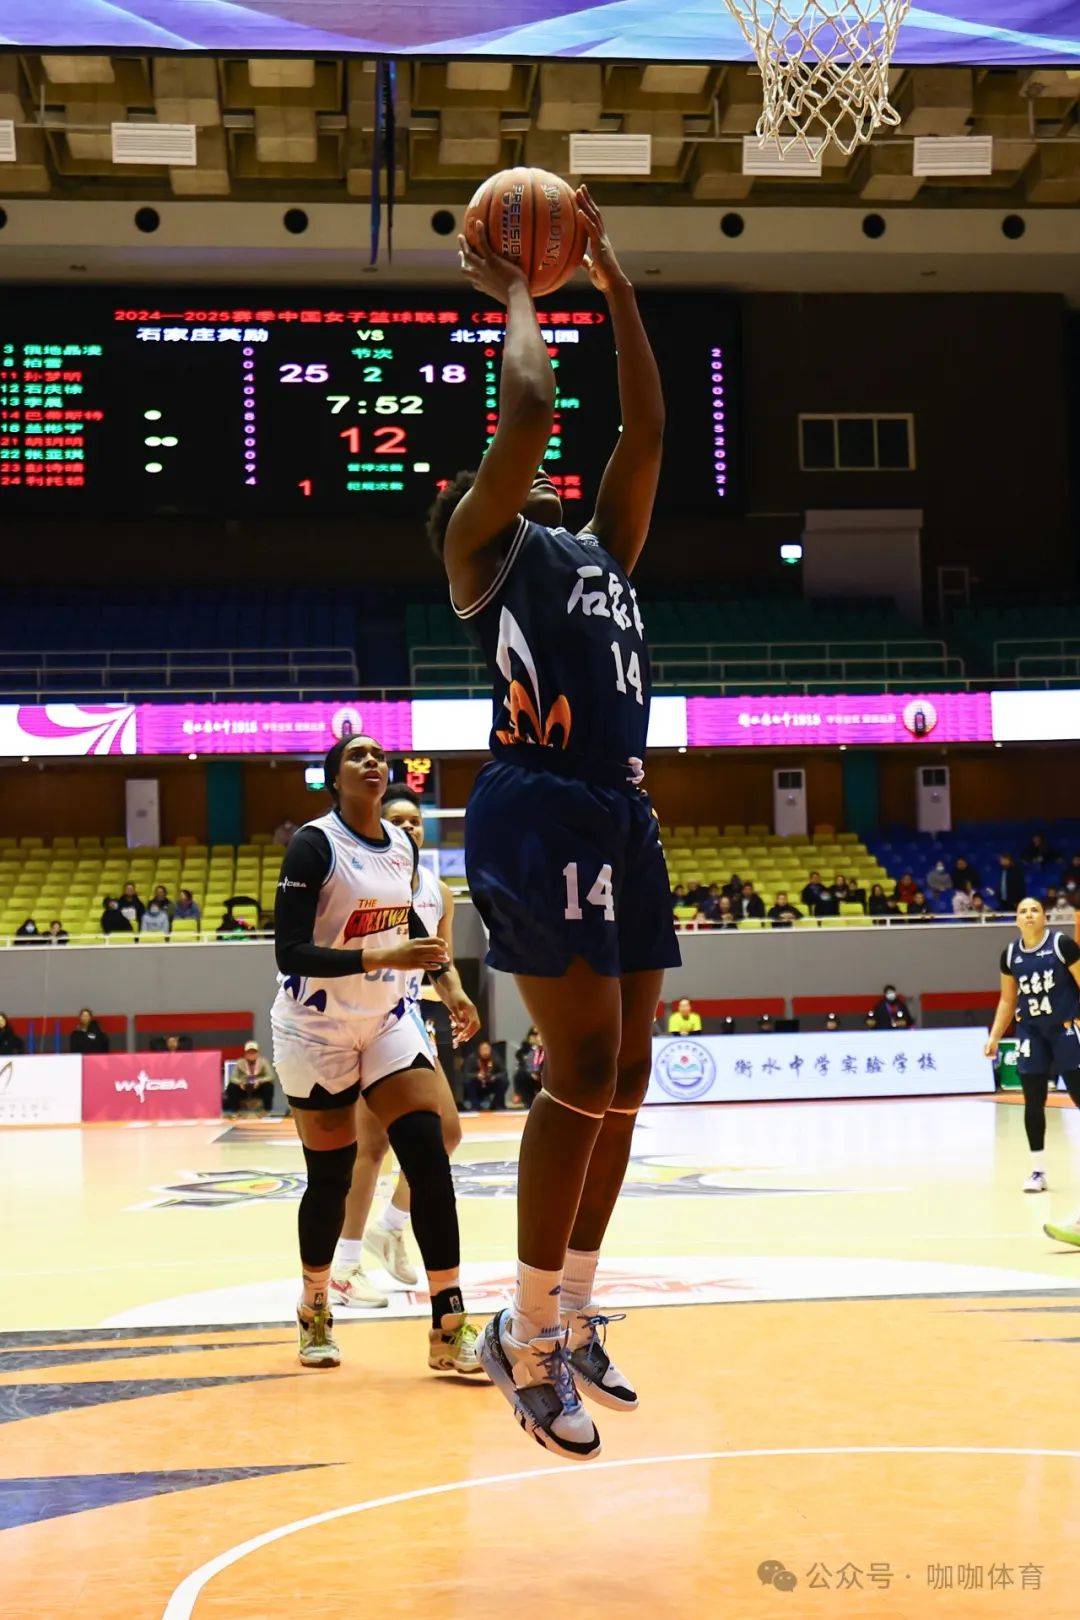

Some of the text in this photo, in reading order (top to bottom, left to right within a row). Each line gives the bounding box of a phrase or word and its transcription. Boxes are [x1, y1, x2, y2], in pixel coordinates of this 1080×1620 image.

[509, 183, 524, 256] PRECISIO
[243, 348, 253, 356] 0
[485, 348, 495, 357] 0
[711, 348, 721, 357] 2
[243, 361, 254, 369] 0
[711, 361, 722, 369] 0
[279, 363, 329, 383] 25
[363, 366, 383, 383] 2
[419, 364, 467, 384] 18
[485, 373, 495, 382] 2
[1, 383, 20, 393] 12
[244, 387, 254, 395] 0
[486, 386, 496, 395] 3
[244, 399, 255, 408] 0
[326, 395, 424, 415] 7:52
[2, 410, 20, 420] 14
[713, 412, 723, 421] 0
[245, 425, 256, 434] 0
[245, 438, 256, 447] 0
[340, 426, 407, 454] 12
[714, 436, 724, 446] 2
[0, 449, 21, 459] 22
[245, 451, 256, 459] 0
[715, 462, 726, 471] 0
[716, 475, 726, 484] 2
[298, 479, 312, 496] 1
[611, 641, 644, 706] 14
[562, 862, 615, 921] 14
[359, 899, 378, 908] THE
[1028, 996, 1053, 1017] 24
[733, 1053, 938, 1079] 衡水中学实验学校
[115, 1074, 188, 1096] WCBA
